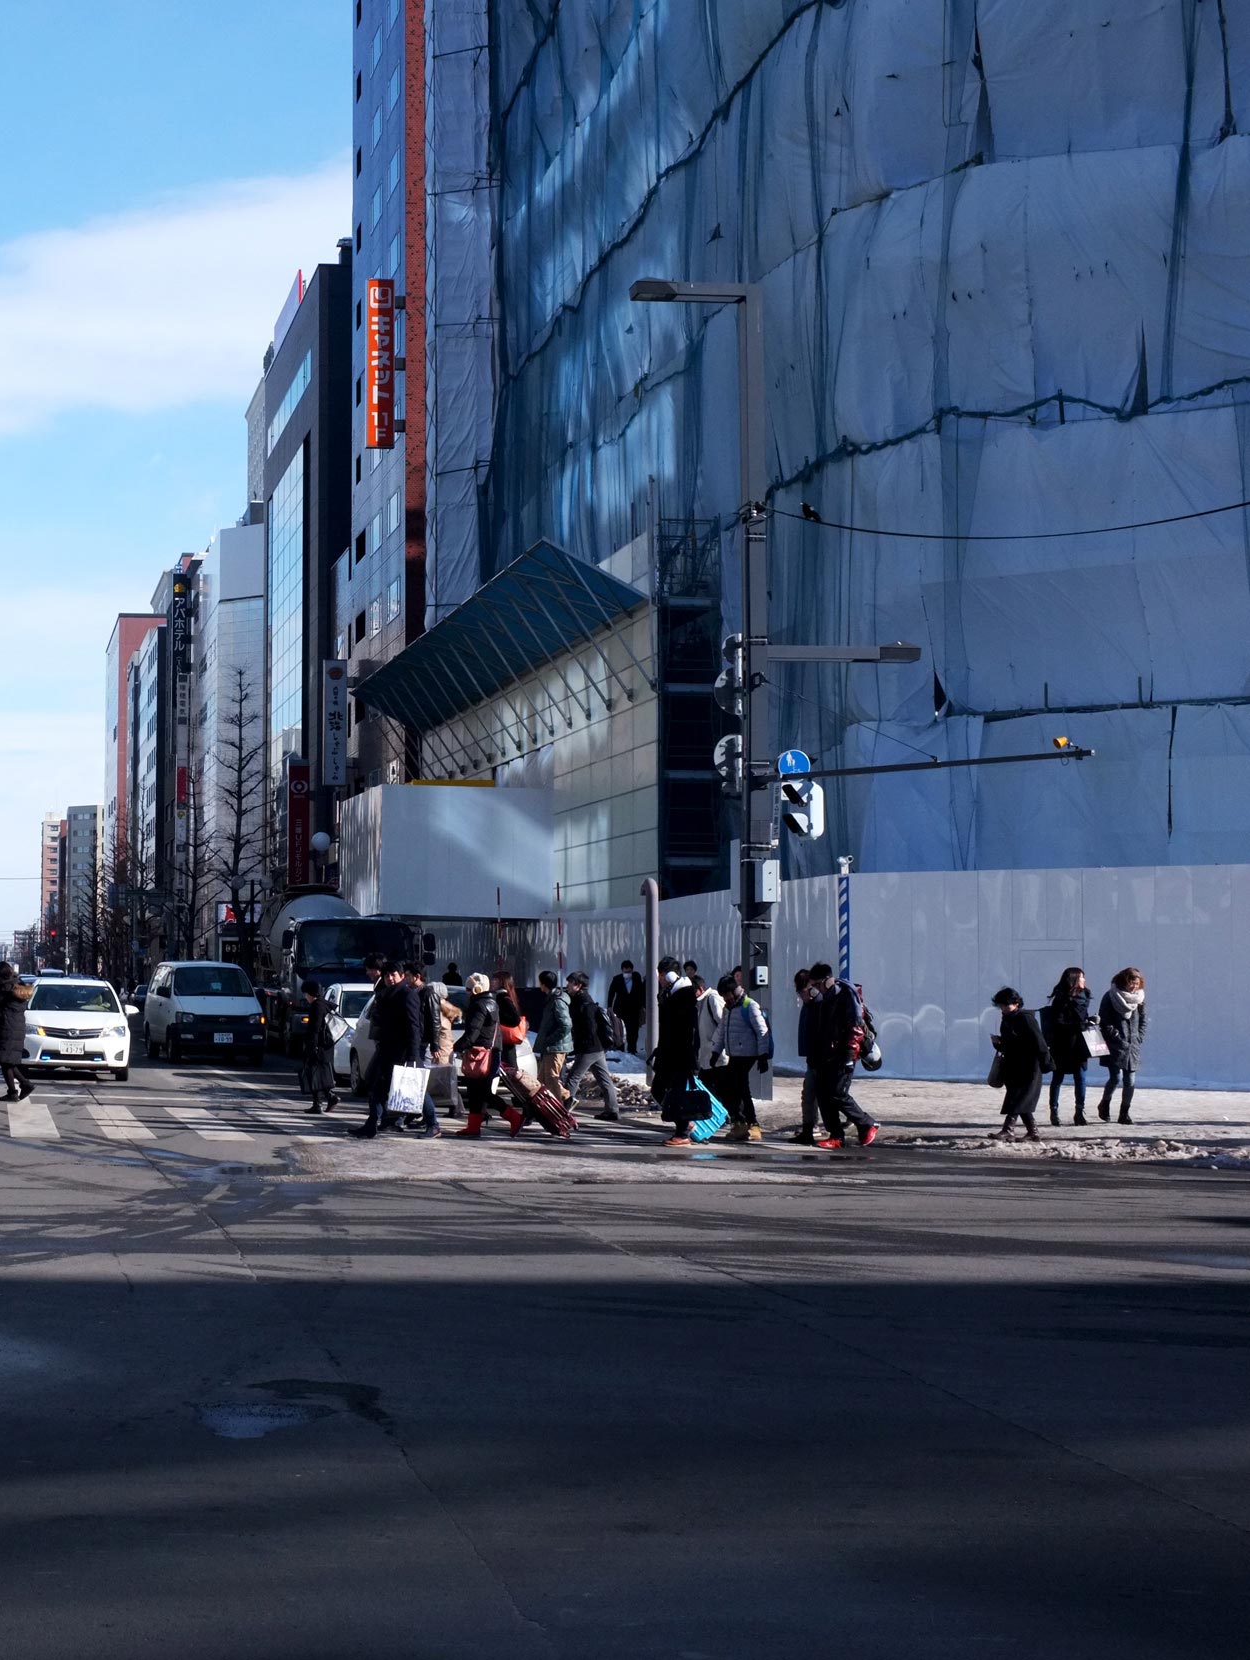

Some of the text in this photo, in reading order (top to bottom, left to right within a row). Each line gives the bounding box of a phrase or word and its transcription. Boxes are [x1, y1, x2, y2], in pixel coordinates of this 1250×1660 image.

[371, 315, 390, 405] キャネット
[174, 597, 186, 651] アパホテル
